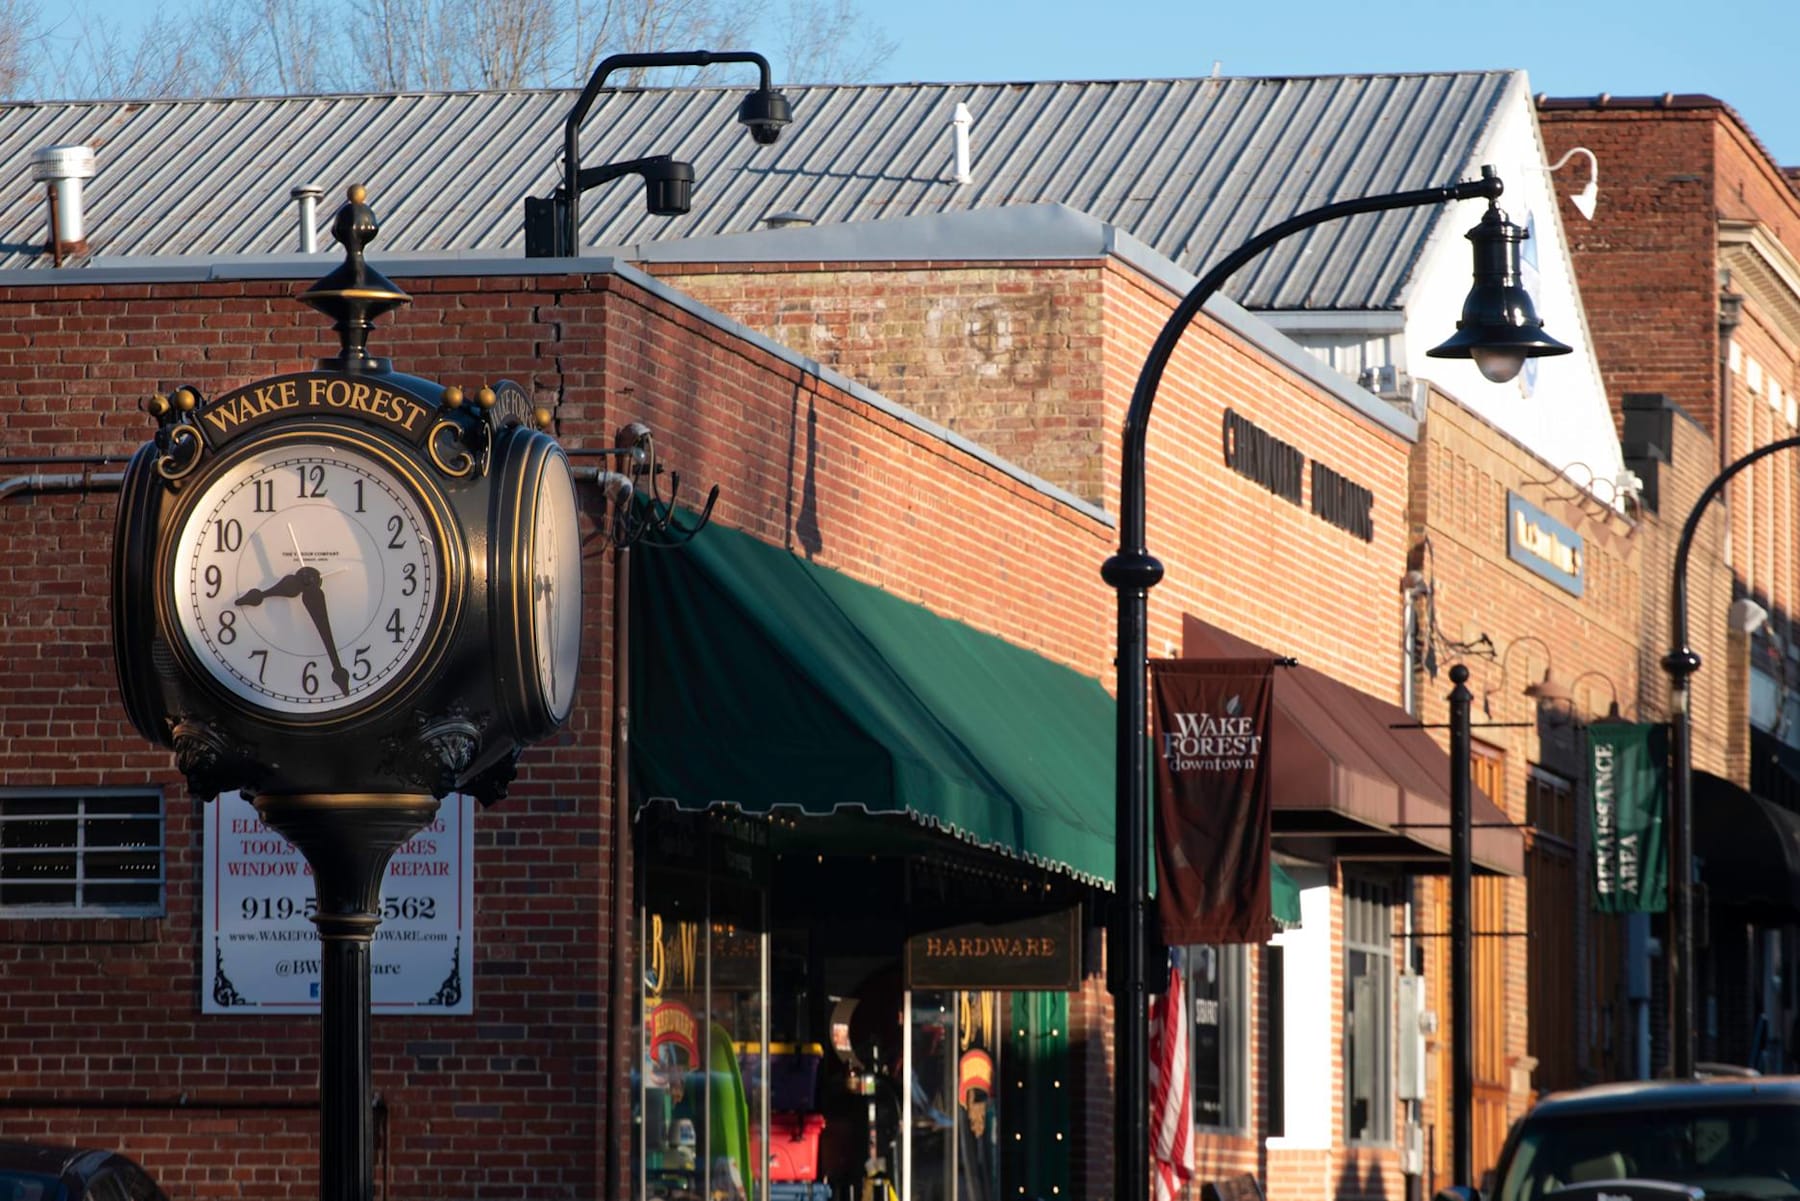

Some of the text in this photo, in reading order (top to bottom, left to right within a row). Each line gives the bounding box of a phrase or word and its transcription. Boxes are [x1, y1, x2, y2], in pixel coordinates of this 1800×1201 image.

[204, 379, 427, 433] WAKE FOREST
[252, 479, 277, 512] 11
[297, 464, 328, 498] 12
[353, 479, 366, 512] 1
[214, 518, 243, 552] 10
[387, 515, 406, 549] 2
[204, 564, 222, 598] 9
[402, 563, 417, 597] 3
[217, 610, 236, 645] 8
[386, 608, 405, 643] 4
[248, 650, 268, 684] 7
[302, 661, 319, 695] 6
[352, 644, 371, 681] 5
[1174, 713, 1253, 738] WAKE
[1162, 733, 1262, 759] FOREST
[1170, 753, 1255, 772] downtown
[1595, 743, 1614, 894] RENAISSANCE
[241, 840, 296, 855] TOOLS
[1619, 834, 1638, 894] AREA
[228, 861, 299, 876] WINDOW
[390, 861, 449, 876] REPAIR
[241, 896, 436, 920] 919-5-562
[229, 931, 448, 942] www.WAKEFORDWARE.com
[926, 937, 1055, 957] HARDWARE
[275, 960, 401, 977] @BWare
